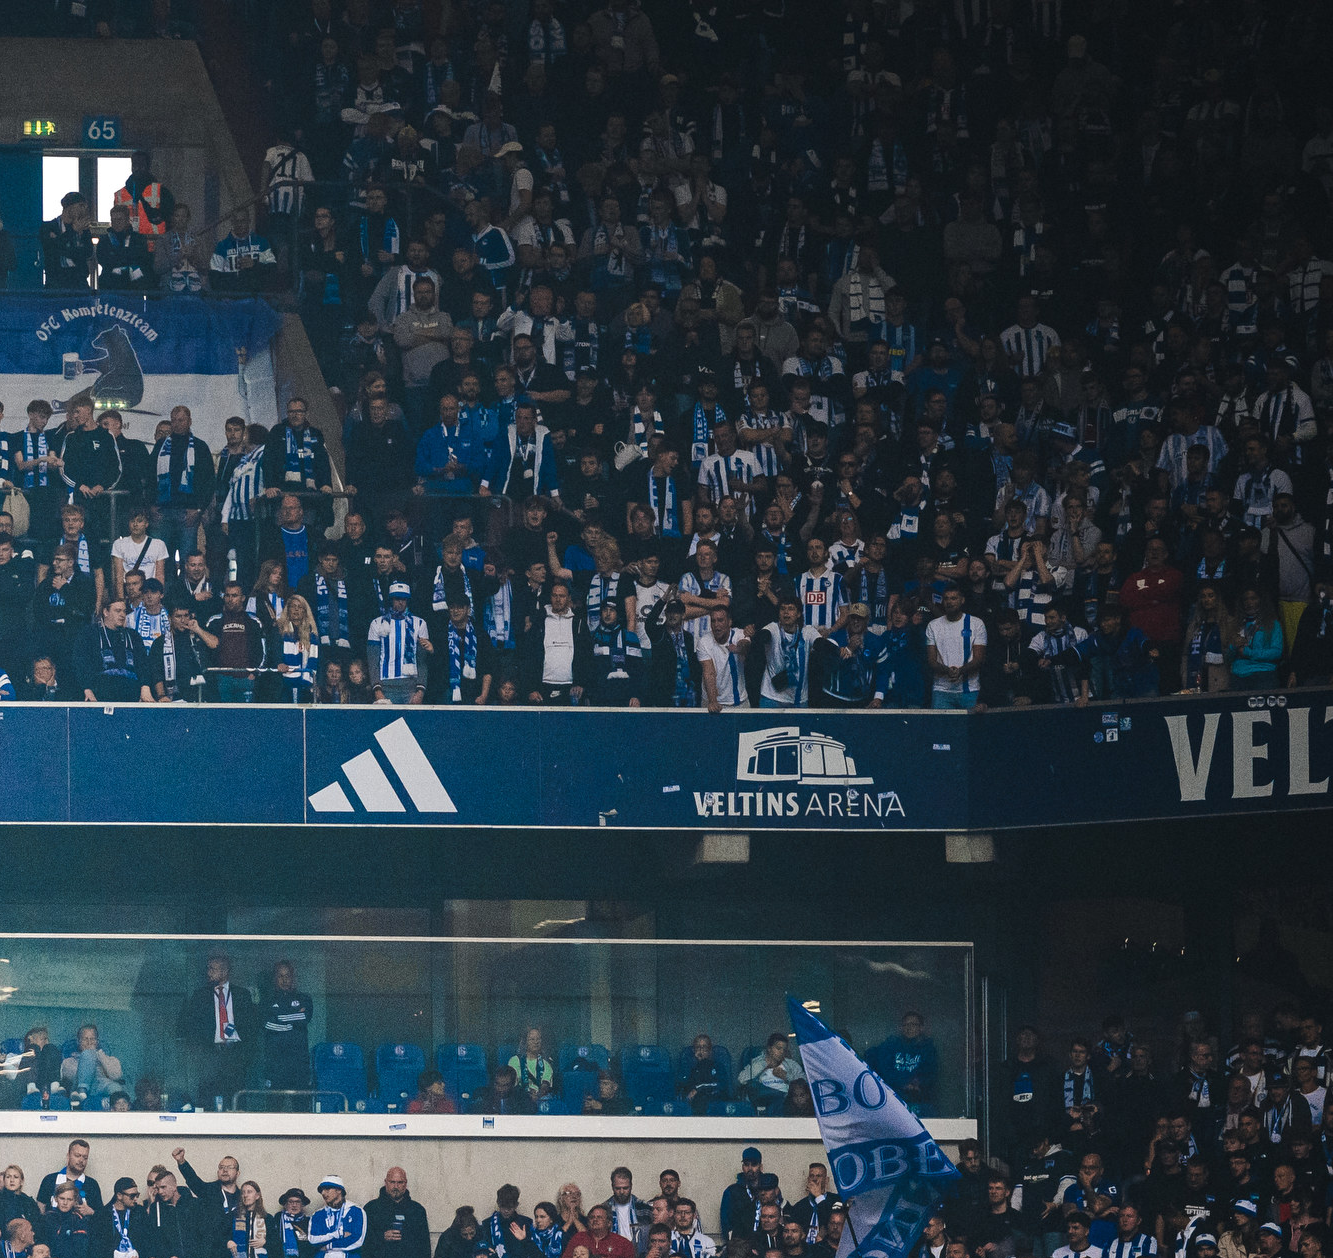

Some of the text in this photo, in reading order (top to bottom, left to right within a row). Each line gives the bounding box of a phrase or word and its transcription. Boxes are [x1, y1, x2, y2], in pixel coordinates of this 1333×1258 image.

[88, 120, 116, 140] 65
[36, 317, 61, 344] OFC
[805, 591, 826, 605] DB
[1165, 705, 1333, 802] VEL
[693, 792, 906, 818] VELTINS ARENA
